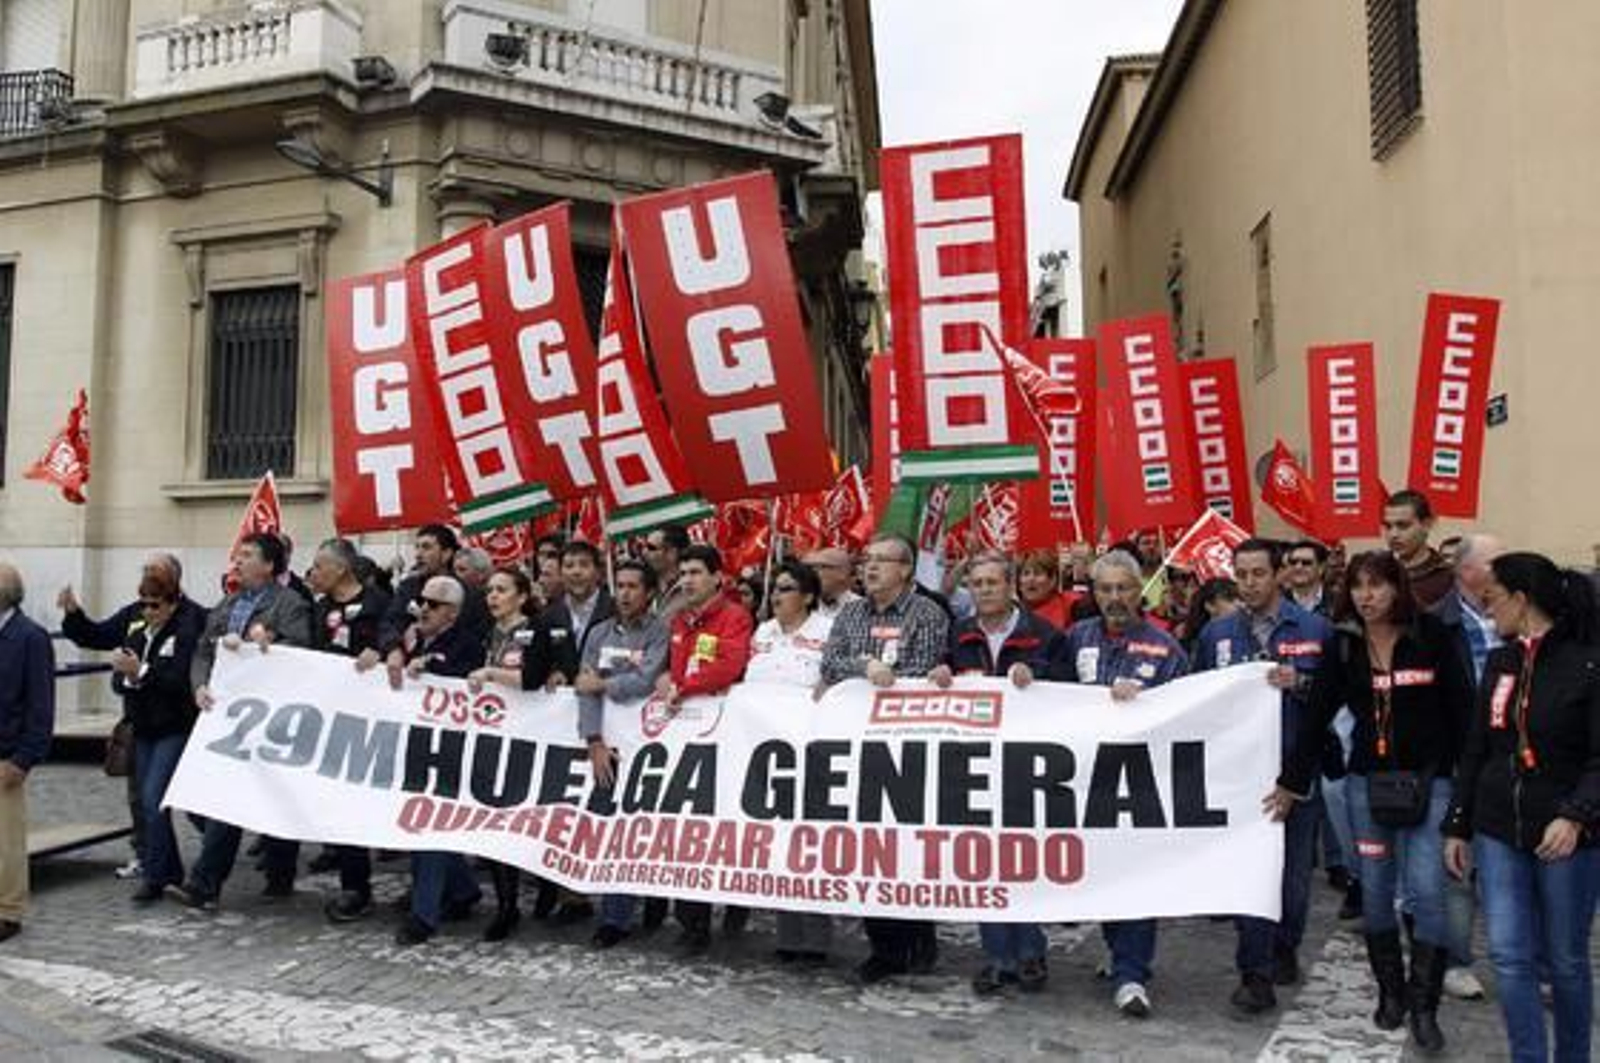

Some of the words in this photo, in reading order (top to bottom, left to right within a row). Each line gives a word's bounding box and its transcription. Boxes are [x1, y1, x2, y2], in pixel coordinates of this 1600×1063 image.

[504, 224, 597, 488] UGT
[661, 196, 787, 487] UGT
[910, 144, 1009, 447] CCOO
[352, 279, 414, 518] UGT
[423, 242, 524, 497] CCOO
[1050, 353, 1076, 475] COO
[1124, 334, 1168, 461] CCOO
[1190, 377, 1231, 493] CCOO
[1327, 357, 1359, 474] CCOO
[1434, 313, 1477, 444] CCOO
[205, 698, 400, 790] 29M
[741, 738, 1229, 829] GENERAL
[398, 796, 605, 860] QUIEREN
[603, 815, 775, 870] ACABAR
[787, 824, 898, 880] CON
[916, 829, 1085, 885] TODO
[542, 847, 588, 882] CON
[615, 864, 713, 890] DERECHOS
[719, 869, 849, 902] LABORALES
[855, 883, 871, 903] Y
[878, 882, 1010, 909] SOCIALES
